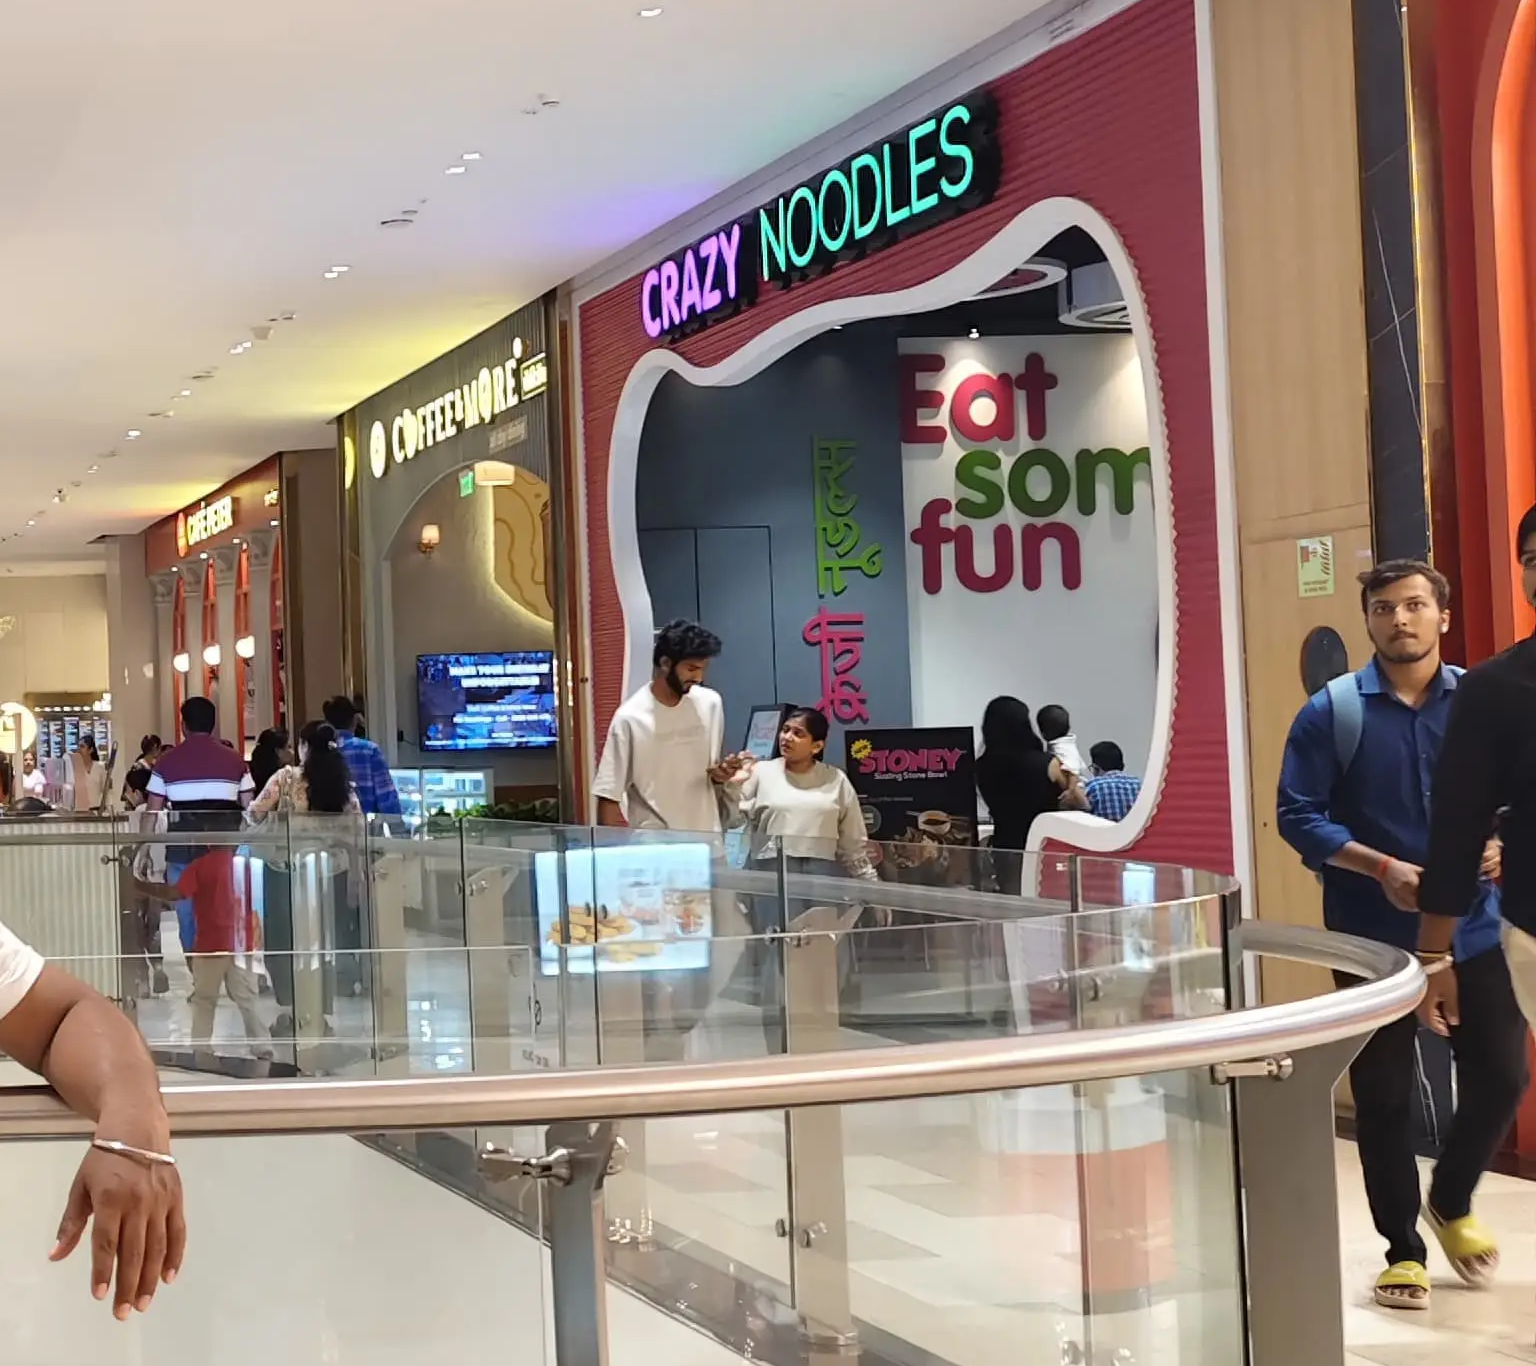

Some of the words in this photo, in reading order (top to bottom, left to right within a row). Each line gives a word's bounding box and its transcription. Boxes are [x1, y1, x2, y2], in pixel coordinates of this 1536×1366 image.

[641, 223, 743, 339] CRAZY
[758, 104, 974, 281] NOODLES
[898, 352, 1058, 444] Eat
[813, 435, 882, 598] नूडल्स
[910, 498, 1082, 595] fun
[859, 747, 961, 774] STONEY
